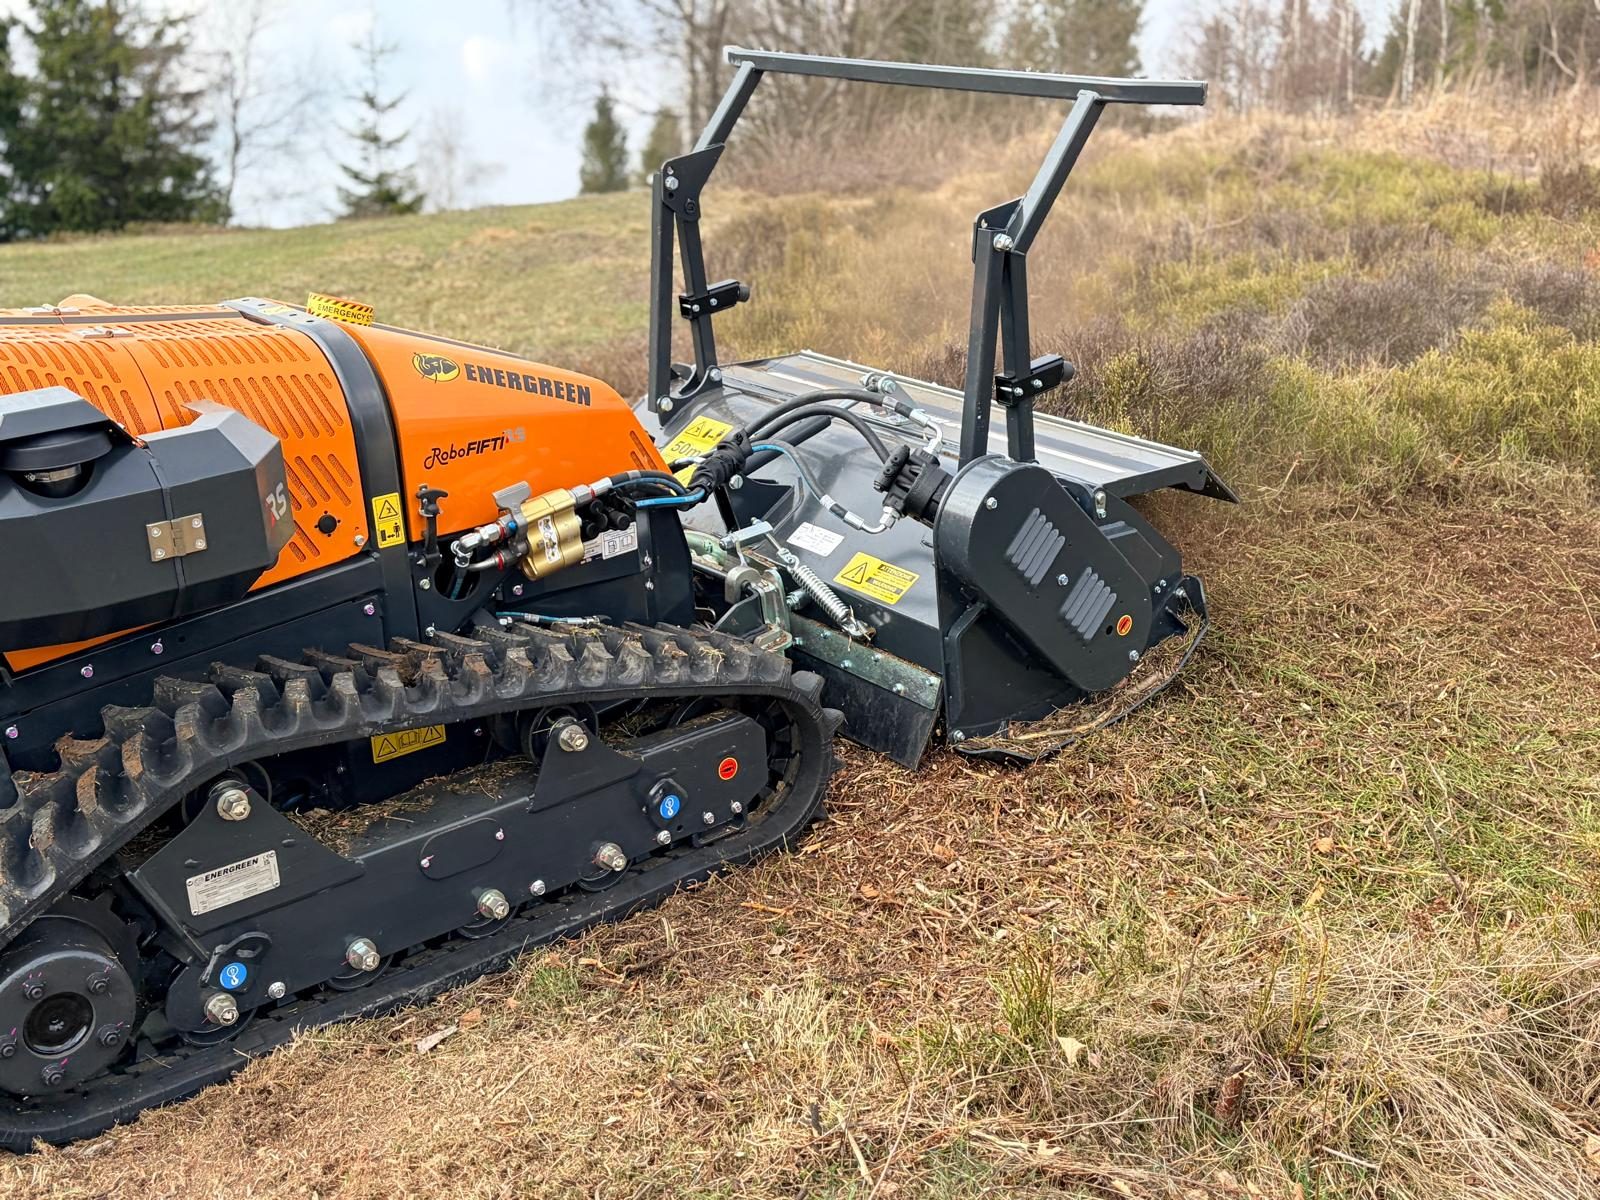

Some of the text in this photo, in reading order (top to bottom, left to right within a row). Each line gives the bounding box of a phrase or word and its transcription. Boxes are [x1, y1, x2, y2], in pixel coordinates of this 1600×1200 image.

[317, 303, 367, 321] EMERGENCY
[464, 363, 592, 406] ENERGREEN
[265, 481, 287, 526] RS
[204, 857, 260, 882] ENERGREEN
